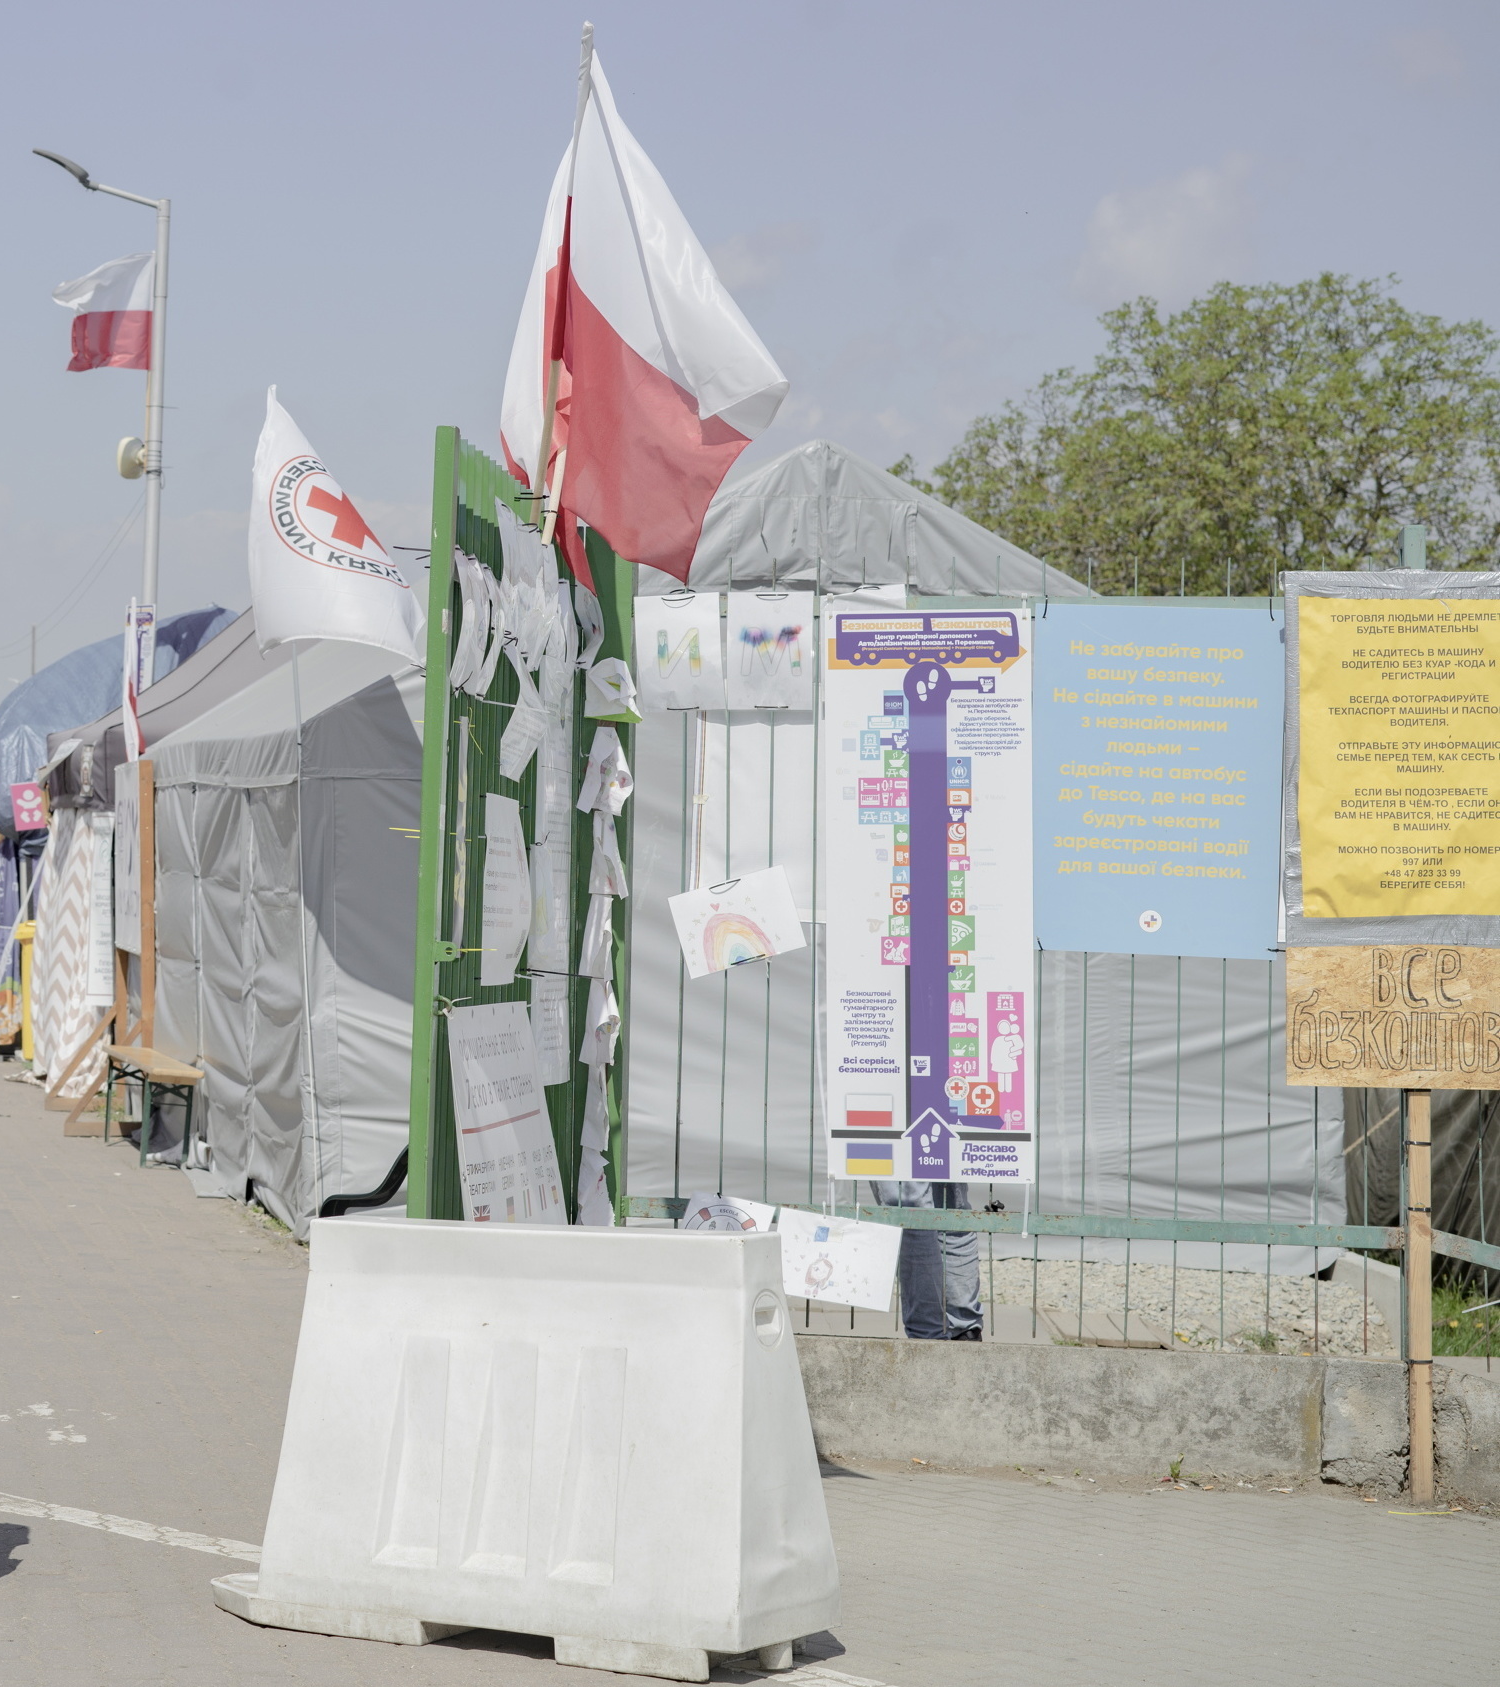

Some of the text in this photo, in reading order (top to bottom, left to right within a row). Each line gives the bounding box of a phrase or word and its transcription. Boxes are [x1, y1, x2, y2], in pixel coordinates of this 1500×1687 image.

[1388, 614, 1433, 623] ЛЮДЬМИ
[1357, 625, 1478, 635] БУДЬТЕ ВНИМАТЕЛЬНЫ
[940, 633, 972, 641] допомоги
[955, 639, 995, 647] Перемишль
[1070, 640, 1244, 662] Не забувайте про
[1353, 649, 1365, 657] НЕ
[1369, 649, 1424, 658] САДИТЕСЬ
[1438, 648, 1484, 656] МАШИНУ
[1342, 661, 1399, 670] ВОДИТЕЛЮ
[1426, 660, 1451, 668] КУАР
[1455, 660, 1485, 668] -КОДА
[1087, 667, 1225, 686] вашу безпеку.
[1382, 672, 1455, 680] РЕГИСТРАЦИИ
[1053, 688, 1258, 708] Не сідайте в машини
[1350, 694, 1489, 704] ВСЕГДА ФОТОГРАФИРУЙТЕ
[1328, 707, 1395, 715] ТЕХПАСПОРТ
[1462, 706, 1500, 714] ПАСПО
[1081, 716, 1227, 731] з незнайомими
[1391, 719, 1448, 727] ВОДИТЕЛЯ.
[1106, 742, 1181, 756] людьми
[1375, 754, 1409, 762] ПЕРЕД
[1412, 754, 1435, 762] ТЕМ,
[1060, 761, 1247, 784] сідайте на автобус
[1058, 785, 1245, 805] до Tesco, де на вас
[1405, 788, 1488, 797] ПОДОЗРЕВАЕТЕ
[1341, 800, 1396, 809] ВОДИТЕЛЯ
[1409, 798, 1448, 807] ЧЁМ-ТО
[1082, 810, 1220, 829] будуть чекати
[1376, 812, 1433, 820] НРАВИТСЯ,
[1394, 823, 1400, 831] В
[1053, 836, 1250, 856] зареєстровані водії
[1339, 846, 1377, 854] МОЖНО
[1381, 846, 1444, 854] ПОЗВОНИТЬ
[1058, 861, 1246, 878] для вашої безпеки.
[1437, 869, 1447, 877] 33
[1450, 869, 1460, 877] 99
[1380, 881, 1431, 889] БЕРЕГИТЕ
[844, 1004, 894, 1012] гуманітарного
[844, 1018, 894, 1026] залізничного/
[851, 1040, 887, 1048] (Przemyśl)
[843, 1057, 894, 1066] Всі сервіси
[839, 1066, 900, 1074] безкоштовні!
[964, 1143, 1016, 1153] Ласкаво
[918, 1157, 943, 1166] 180m
[962, 1153, 1018, 1163] Просимо
